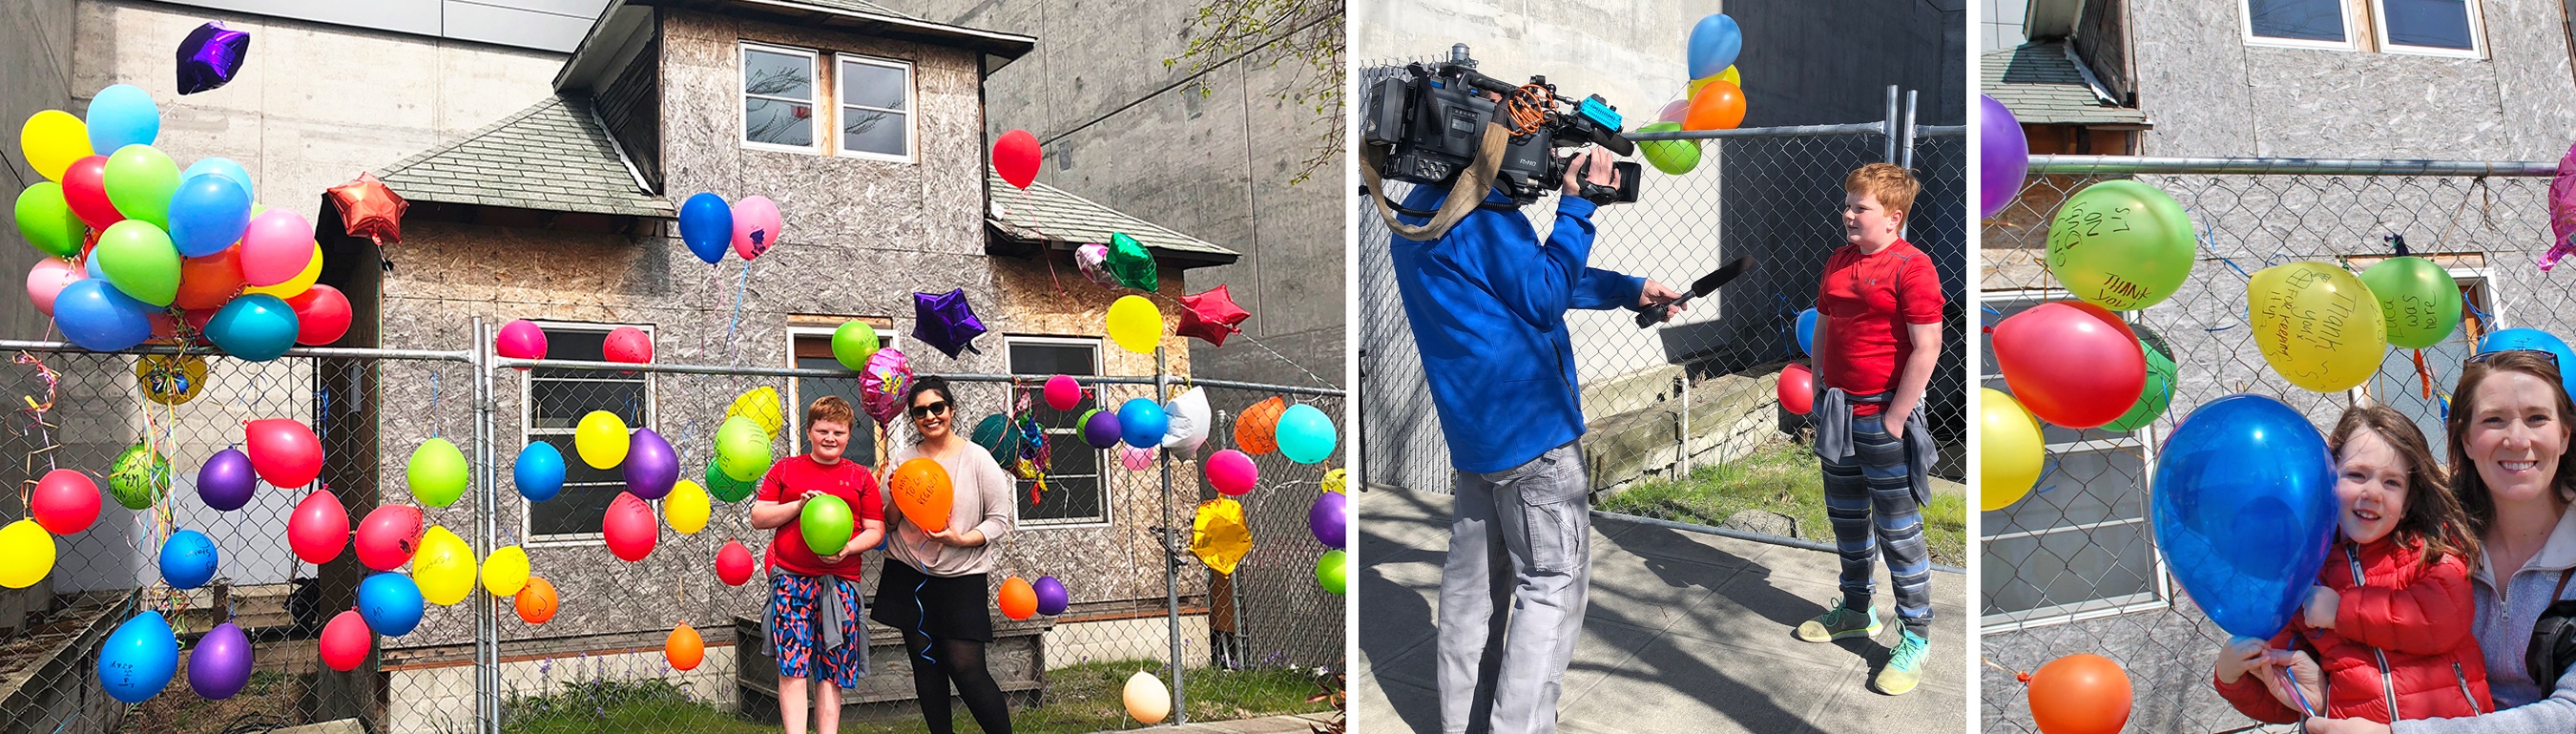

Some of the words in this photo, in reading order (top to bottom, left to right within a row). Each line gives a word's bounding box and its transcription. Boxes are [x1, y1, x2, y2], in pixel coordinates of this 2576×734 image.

[2084, 212, 2103, 237] NO
[2104, 271, 2152, 301] THANK
[2315, 291, 2358, 352] Thank
[2402, 294, 2420, 326] was
[2423, 291, 2438, 330] here
